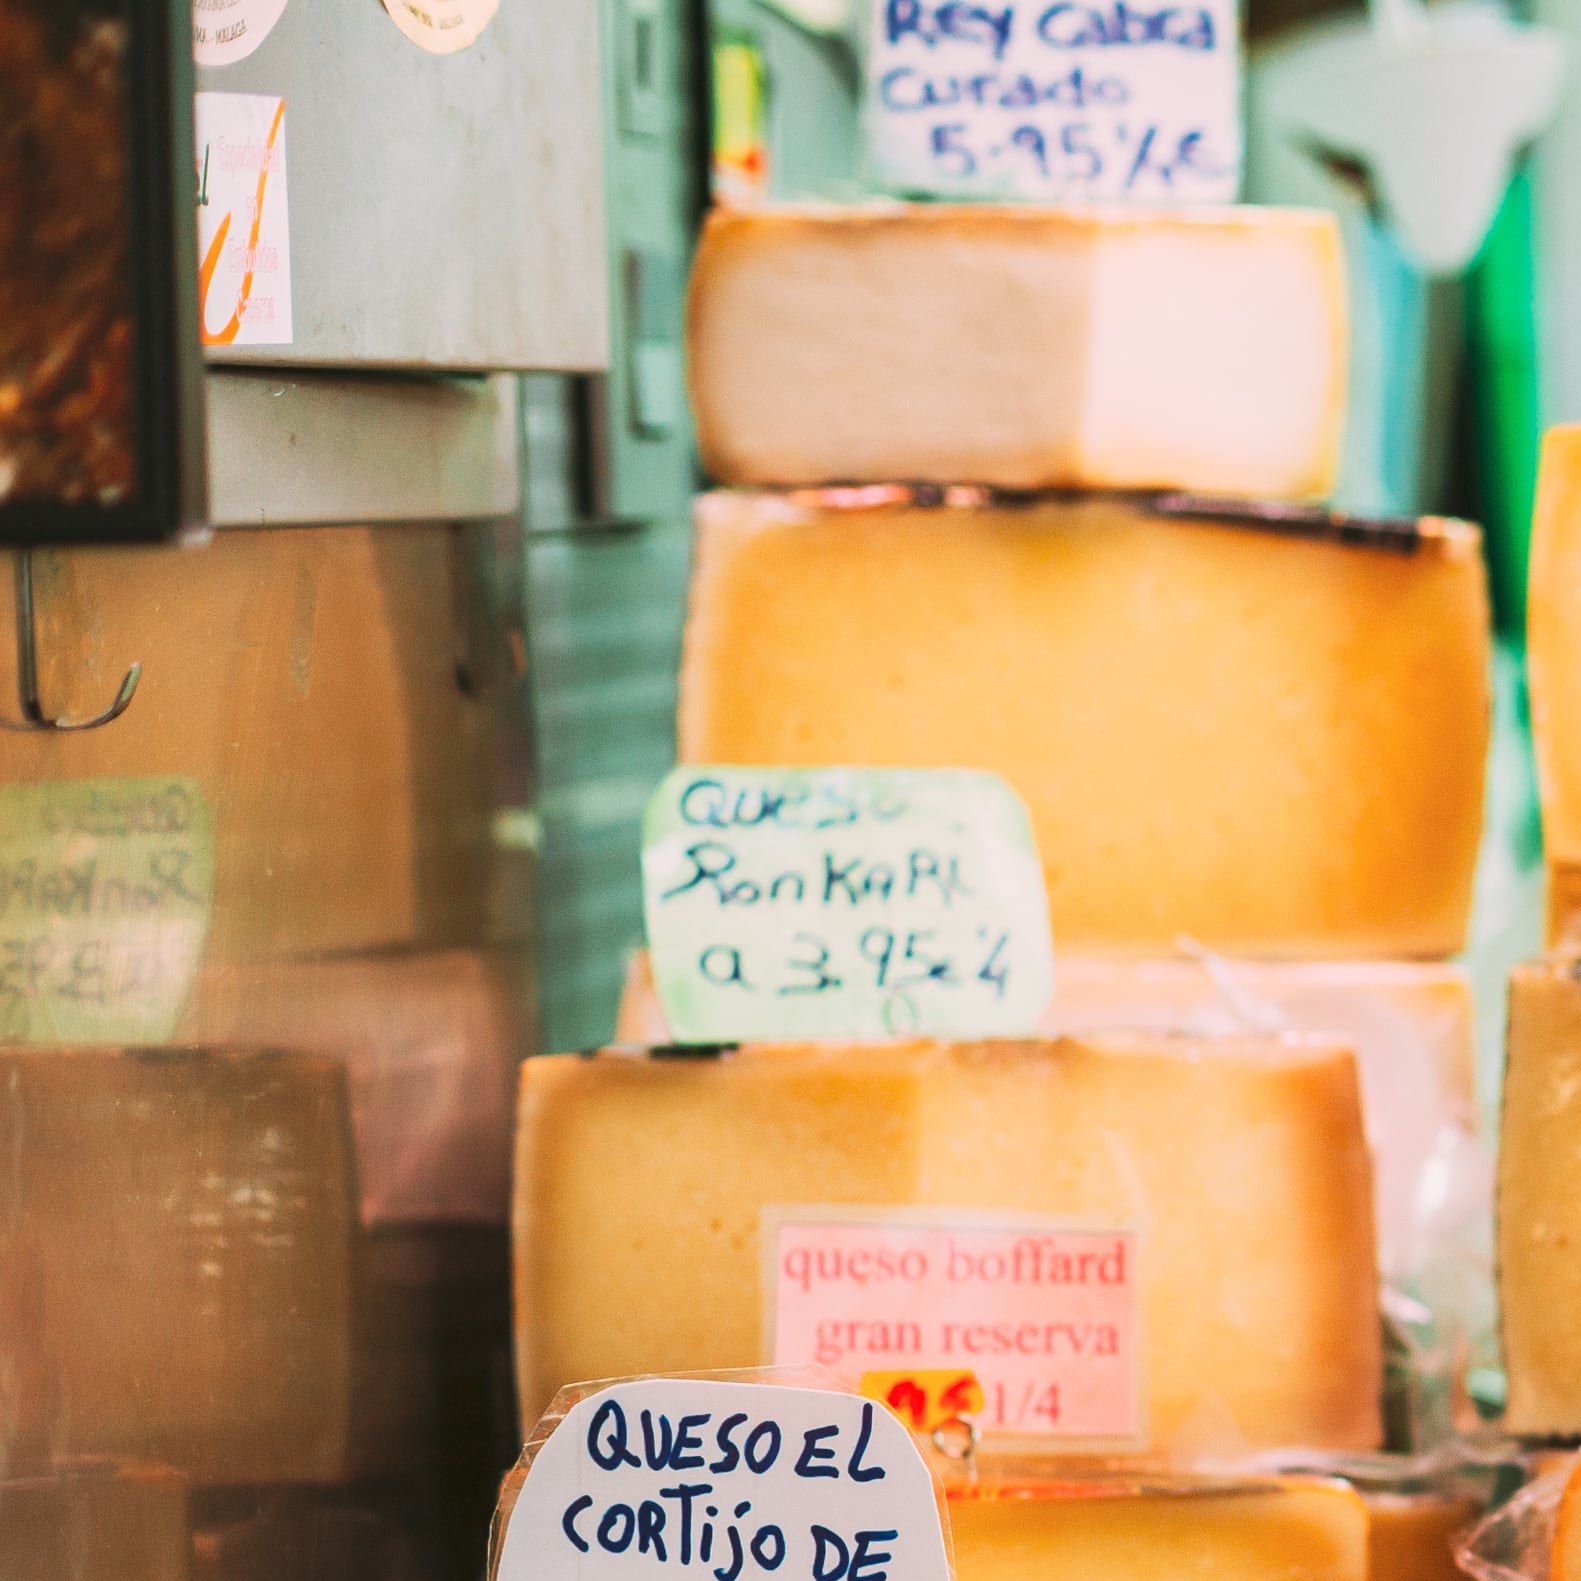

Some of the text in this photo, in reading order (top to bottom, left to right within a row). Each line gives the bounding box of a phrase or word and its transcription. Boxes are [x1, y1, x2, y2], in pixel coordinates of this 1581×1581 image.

[783, 1237, 1126, 1294] queso boffard
[813, 1318, 1121, 1366] gran reserva
[586, 1399, 886, 1483] QUESO EL
